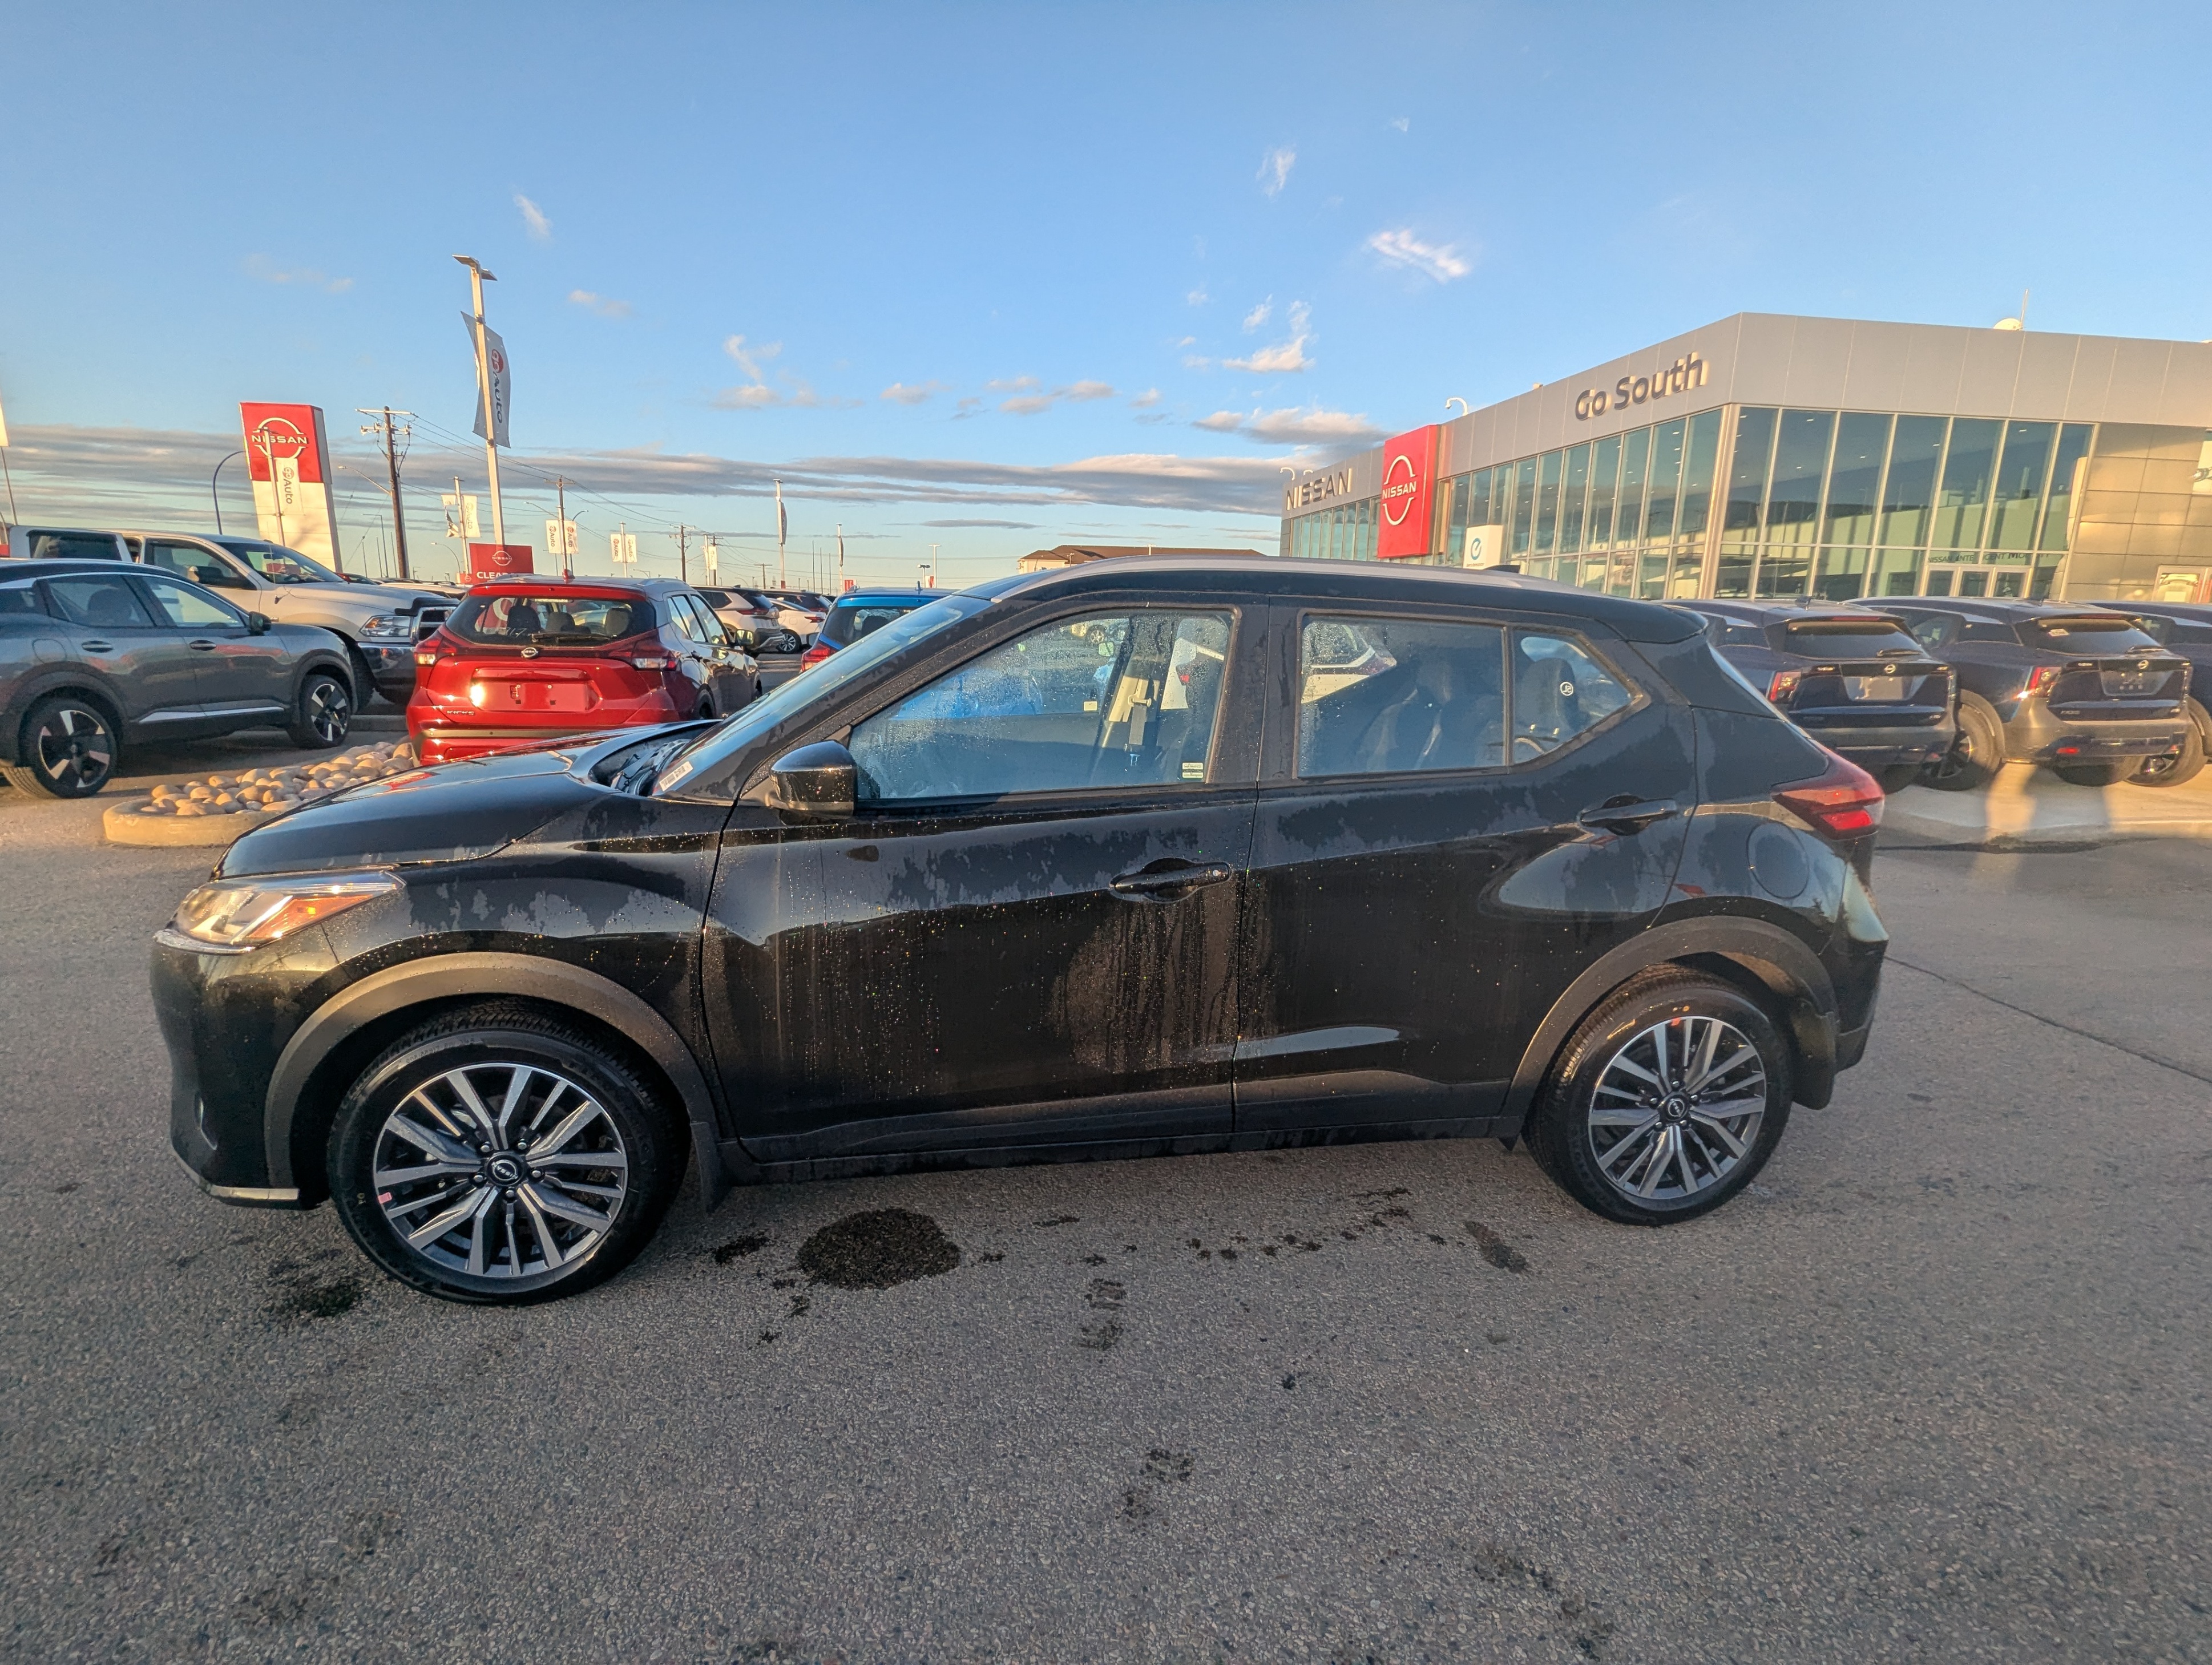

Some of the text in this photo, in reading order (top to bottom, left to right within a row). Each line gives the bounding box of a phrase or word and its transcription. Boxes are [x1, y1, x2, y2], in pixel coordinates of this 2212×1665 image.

[1575, 351, 1708, 421] Go South
[252, 435, 307, 444] NISSAN
[1286, 468, 1353, 511] NISSAN
[1382, 481, 1416, 500] NISSAN
